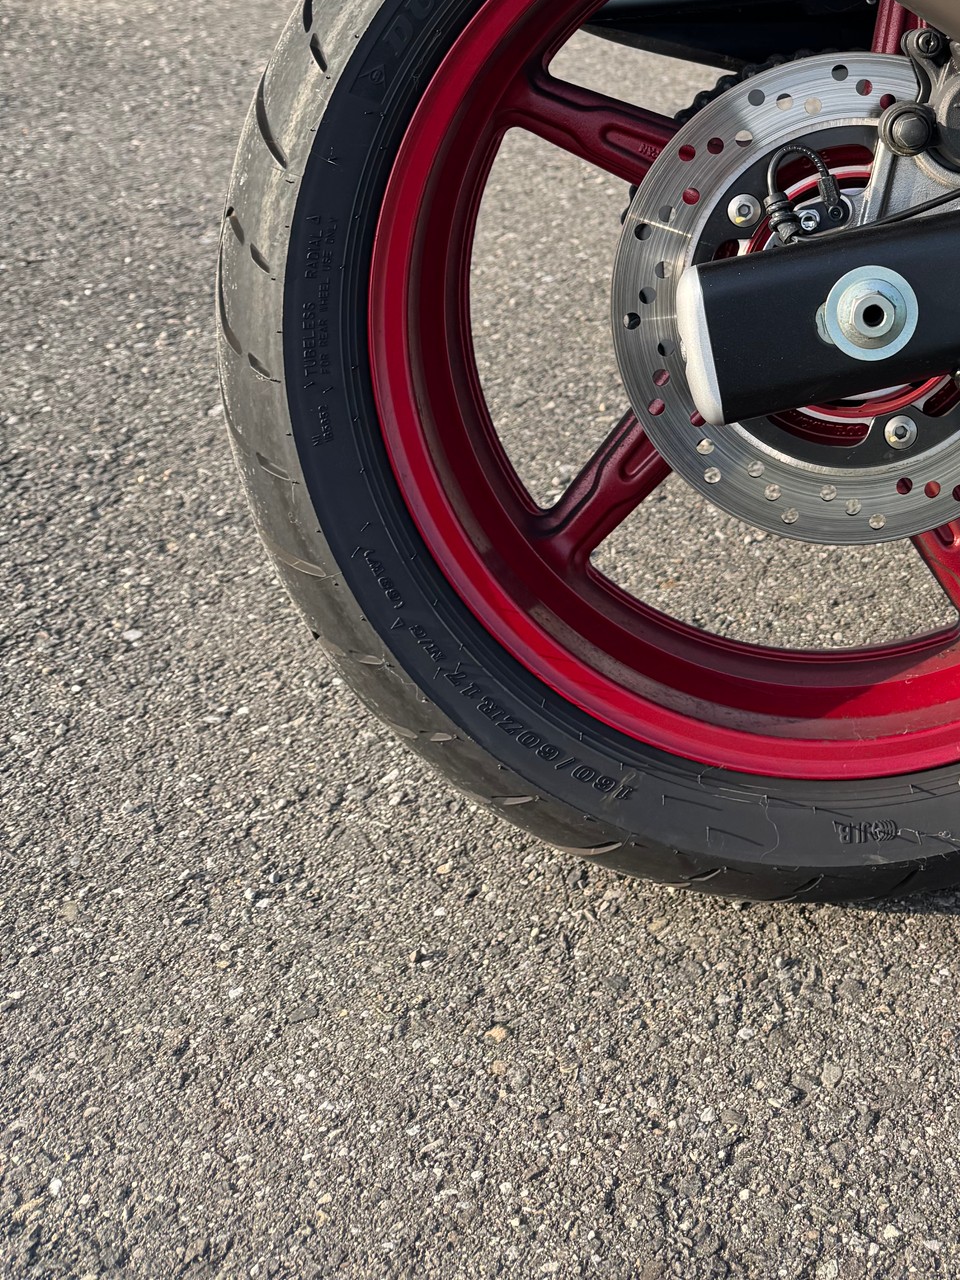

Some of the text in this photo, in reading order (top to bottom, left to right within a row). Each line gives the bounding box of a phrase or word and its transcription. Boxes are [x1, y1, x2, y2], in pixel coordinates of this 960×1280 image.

[303, 229, 324, 377] TUBELESS RADIAL
[317, 216, 338, 376] FOR REAR WHEEL USE ONLY
